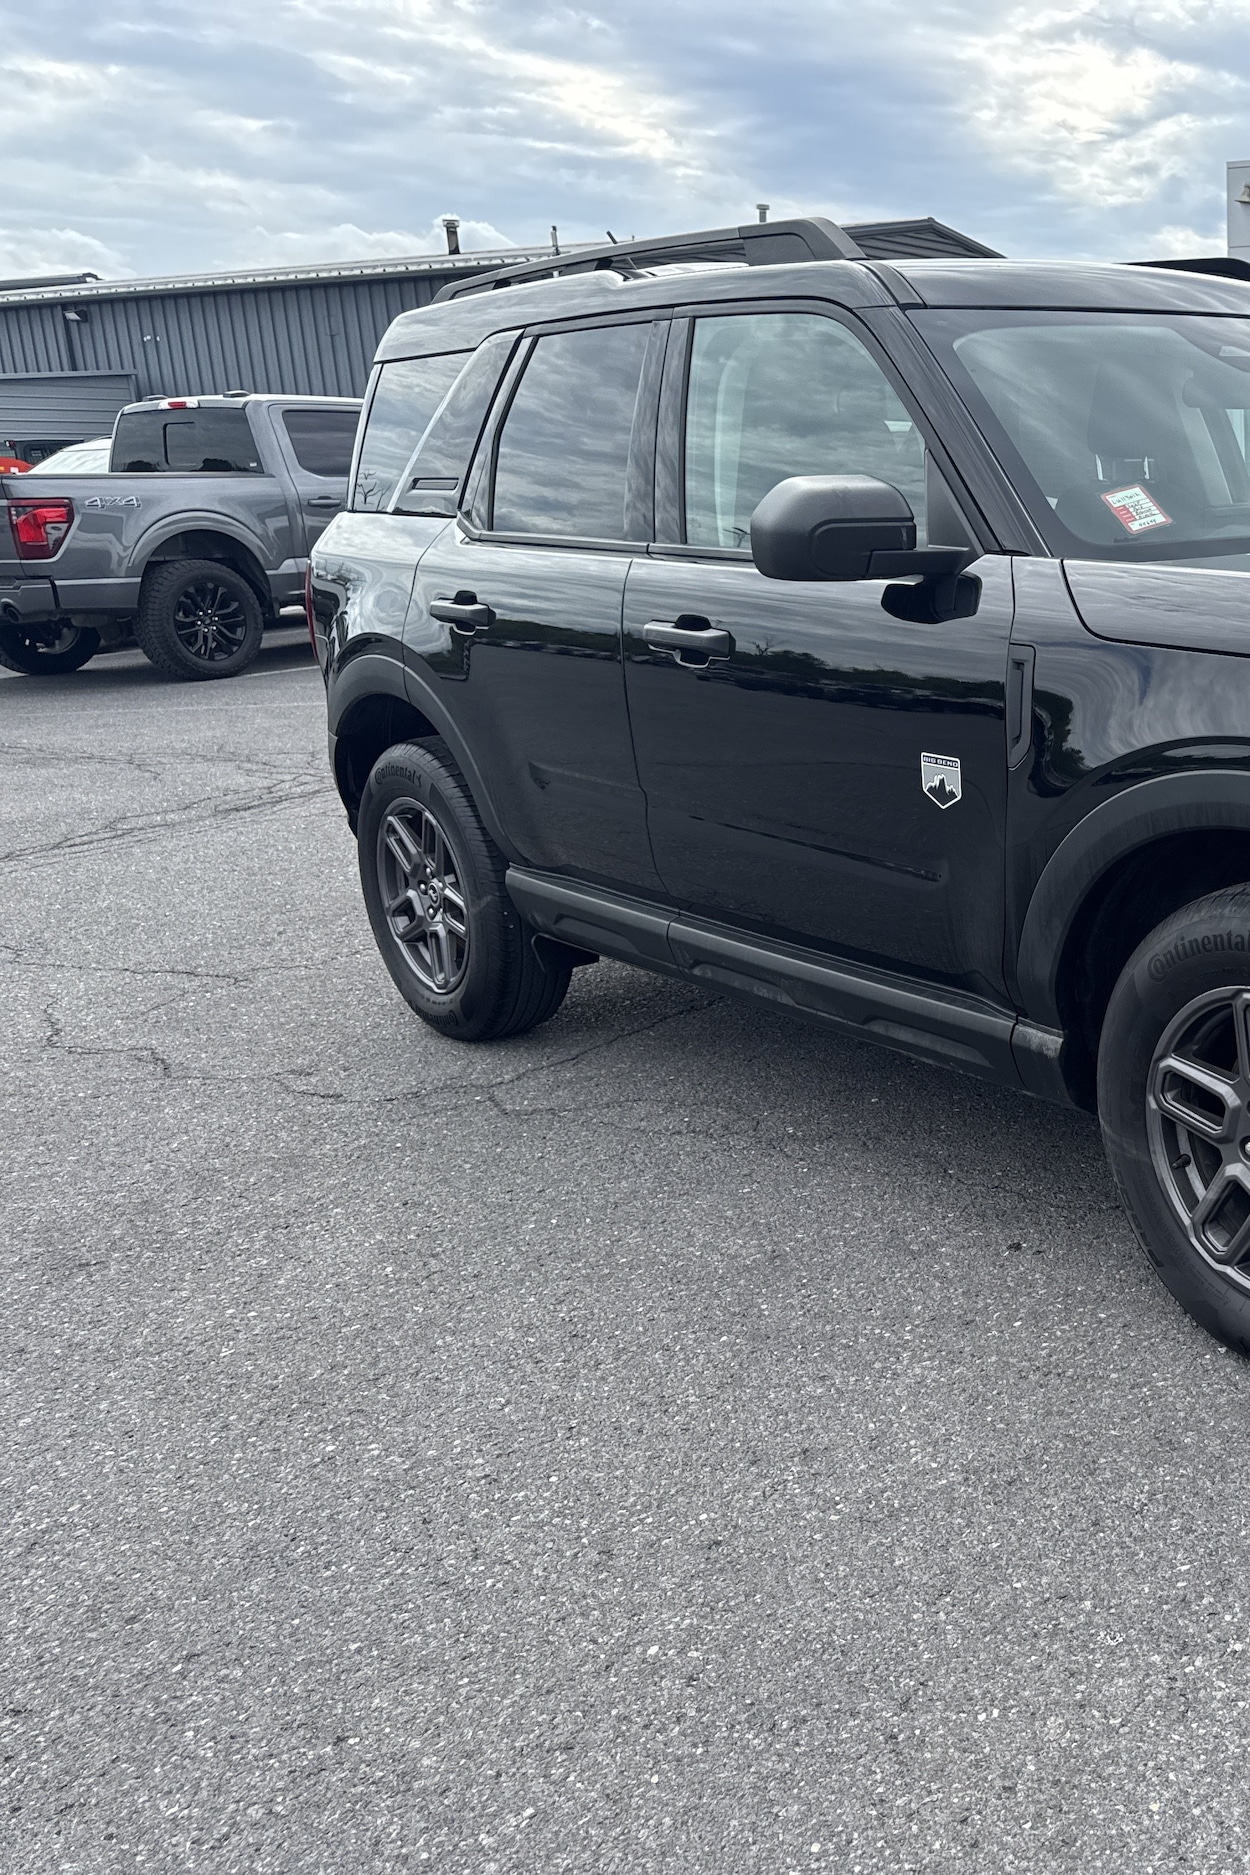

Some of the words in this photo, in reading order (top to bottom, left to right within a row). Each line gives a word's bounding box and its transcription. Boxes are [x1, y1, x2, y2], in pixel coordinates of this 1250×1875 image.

[923, 756, 937, 765] BIG
[937, 758, 958, 768] BEND
[374, 762, 418, 785] Continental
